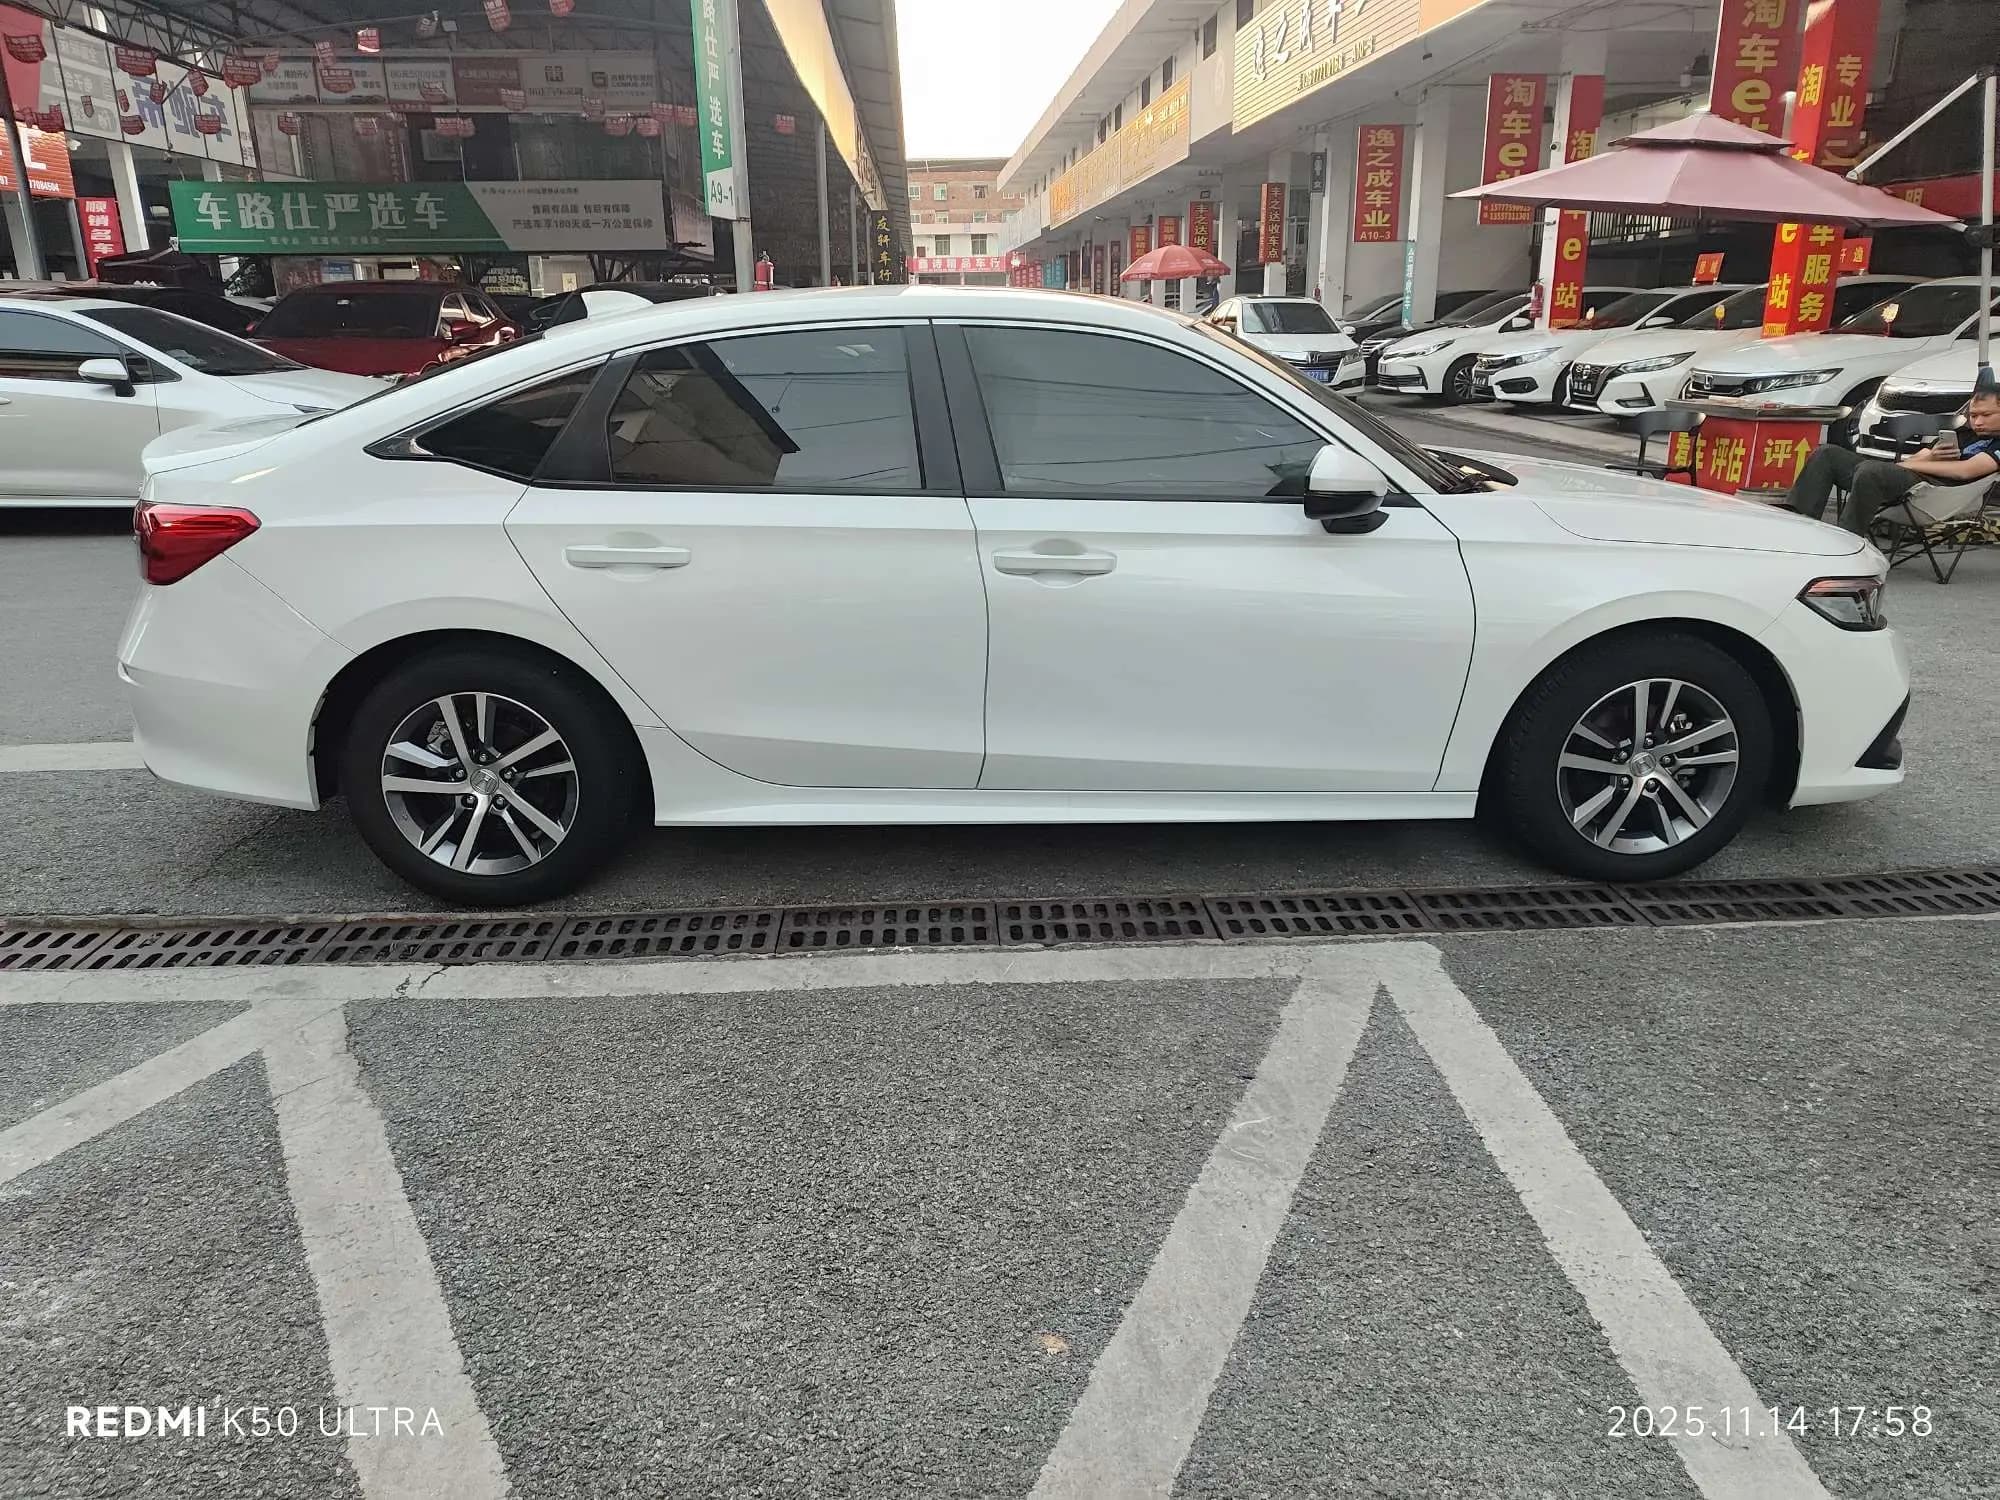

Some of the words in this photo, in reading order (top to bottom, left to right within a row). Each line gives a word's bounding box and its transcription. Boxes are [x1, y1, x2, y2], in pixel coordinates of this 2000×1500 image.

[711, 180, 734, 207] A9-1
[1363, 129, 1396, 228] 逸之成车业
[1799, 54, 1863, 322] 专业二车服务
[193, 191, 448, 231] 车路仕严选车
[1359, 230, 1391, 241] A10-3
